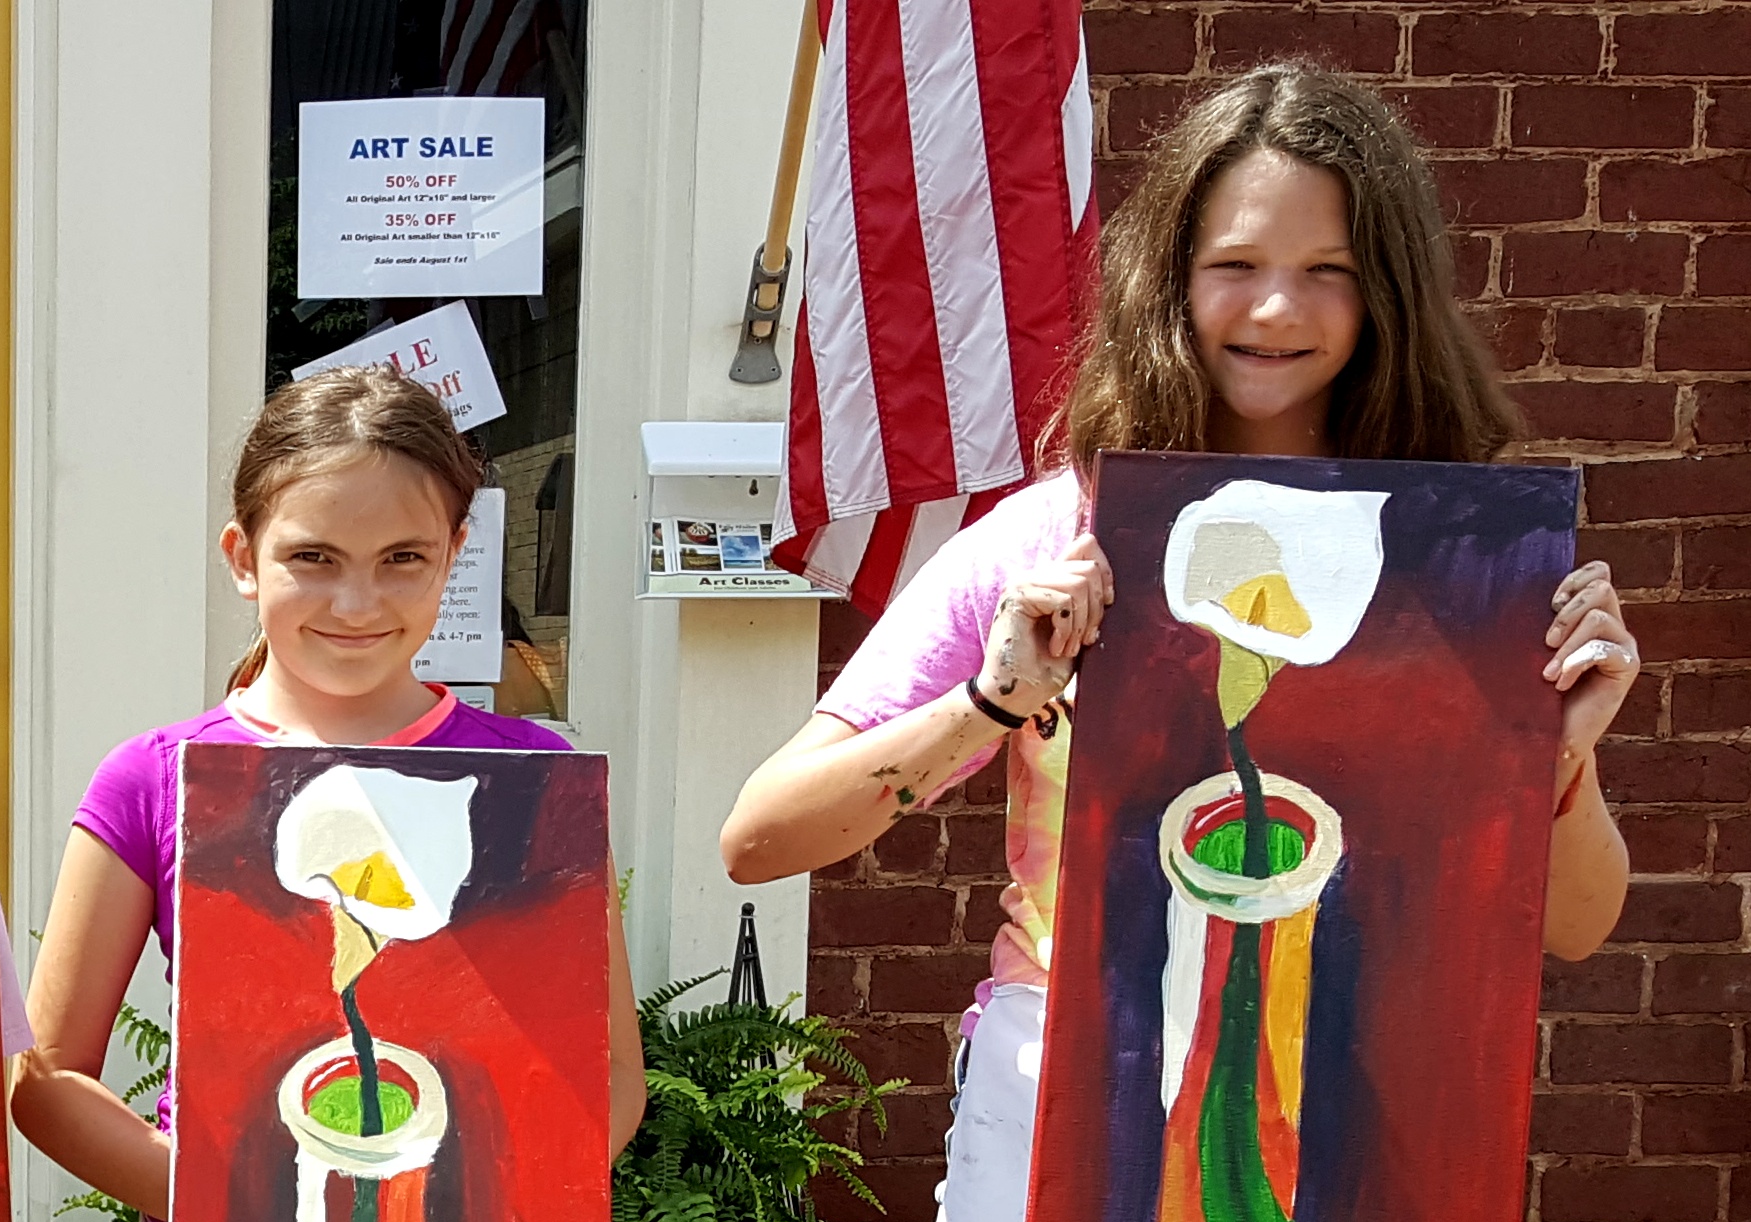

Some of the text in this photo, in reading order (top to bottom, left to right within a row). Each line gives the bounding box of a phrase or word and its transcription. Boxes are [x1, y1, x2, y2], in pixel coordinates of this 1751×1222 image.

[349, 136, 494, 160] ART SALE
[385, 174, 458, 188] 50% OFF
[346, 195, 358, 203] All
[360, 194, 396, 204] Original
[398, 194, 411, 202] Art
[451, 194, 468, 202] and
[469, 193, 497, 203] larger
[385, 213, 457, 227] 35% OFF
[340, 234, 353, 242] All
[354, 233, 390, 243] Original
[392, 233, 406, 241] Art
[408, 232, 441, 240] smaller
[443, 232, 463, 240] than
[418, 256, 451, 266] August
[382, 337, 438, 375] LE
[698, 575, 790, 586] Art Classes
[449, 631, 464, 640] 4-7
[466, 633, 482, 642] pm
[415, 659, 431, 669] pm
